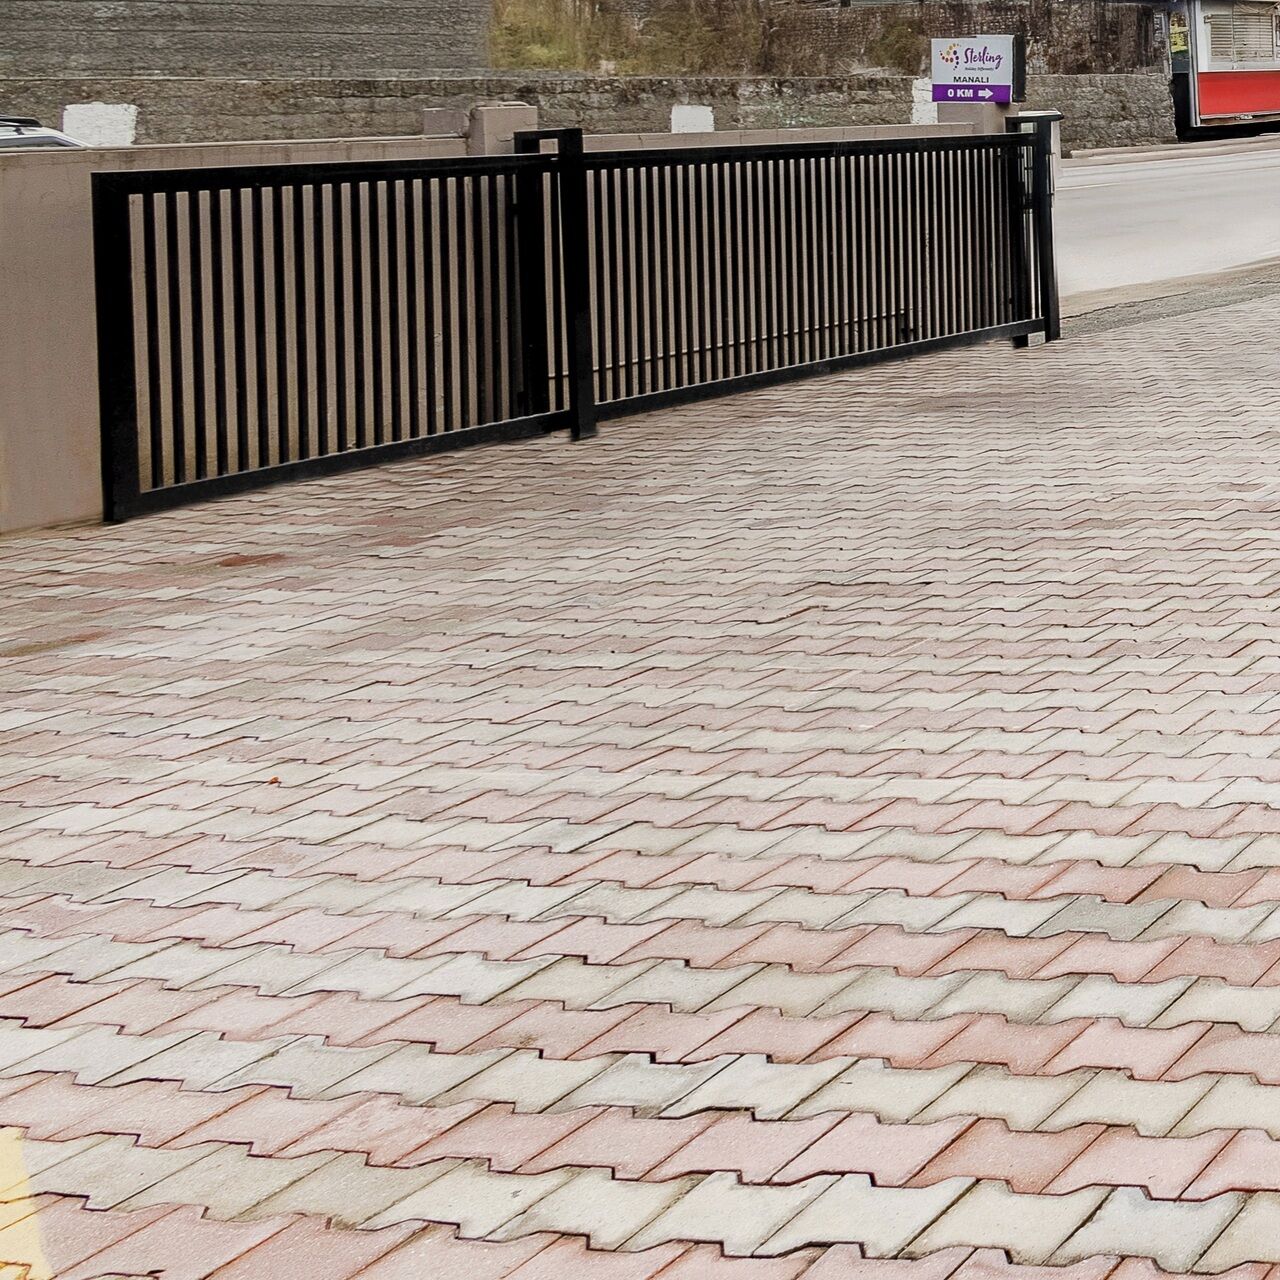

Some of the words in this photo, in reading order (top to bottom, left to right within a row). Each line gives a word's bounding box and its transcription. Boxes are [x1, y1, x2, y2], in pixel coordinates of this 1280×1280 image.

[964, 46, 1003, 70] Sterling
[947, 89, 954, 97] 0
[956, 89, 973, 98] KM
